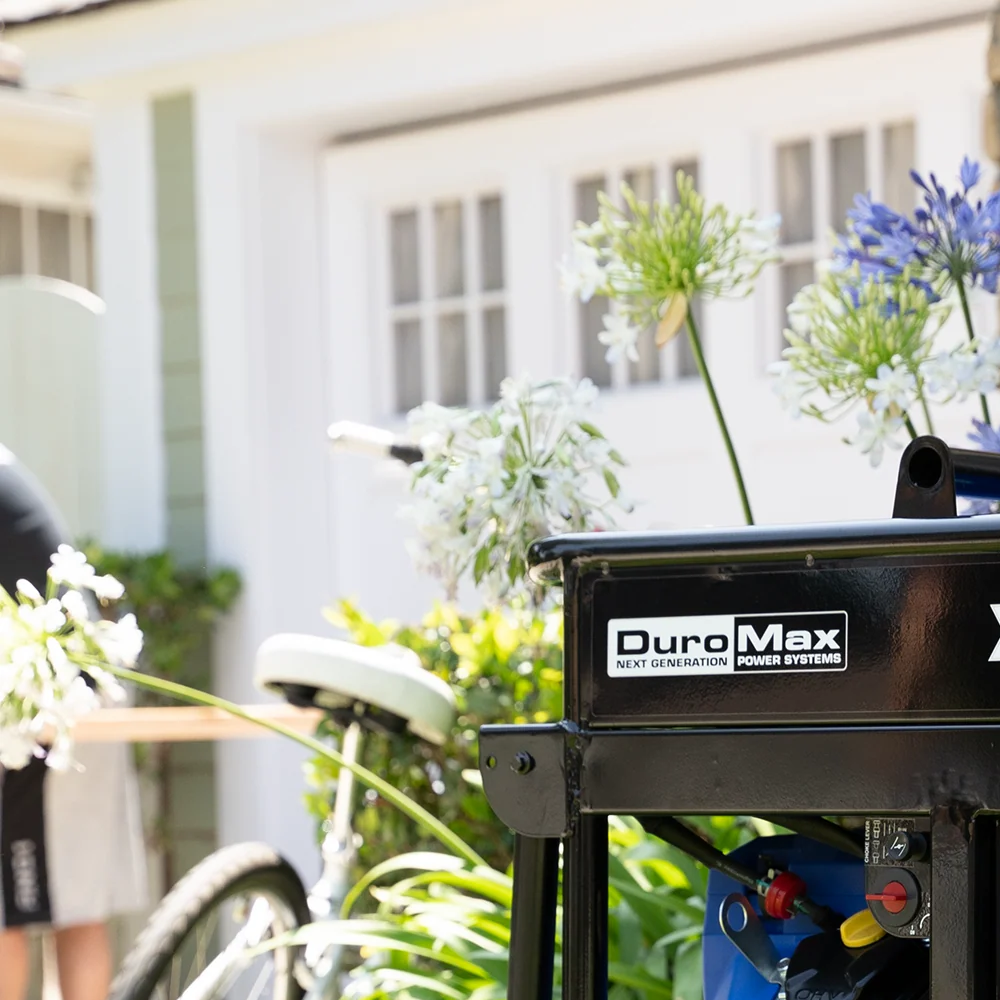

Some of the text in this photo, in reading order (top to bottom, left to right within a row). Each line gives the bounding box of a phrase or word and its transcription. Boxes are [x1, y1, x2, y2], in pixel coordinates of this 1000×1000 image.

[616, 657, 728, 669] NEXT GENERATION
[737, 653, 841, 666] POWER SYSTEMS
